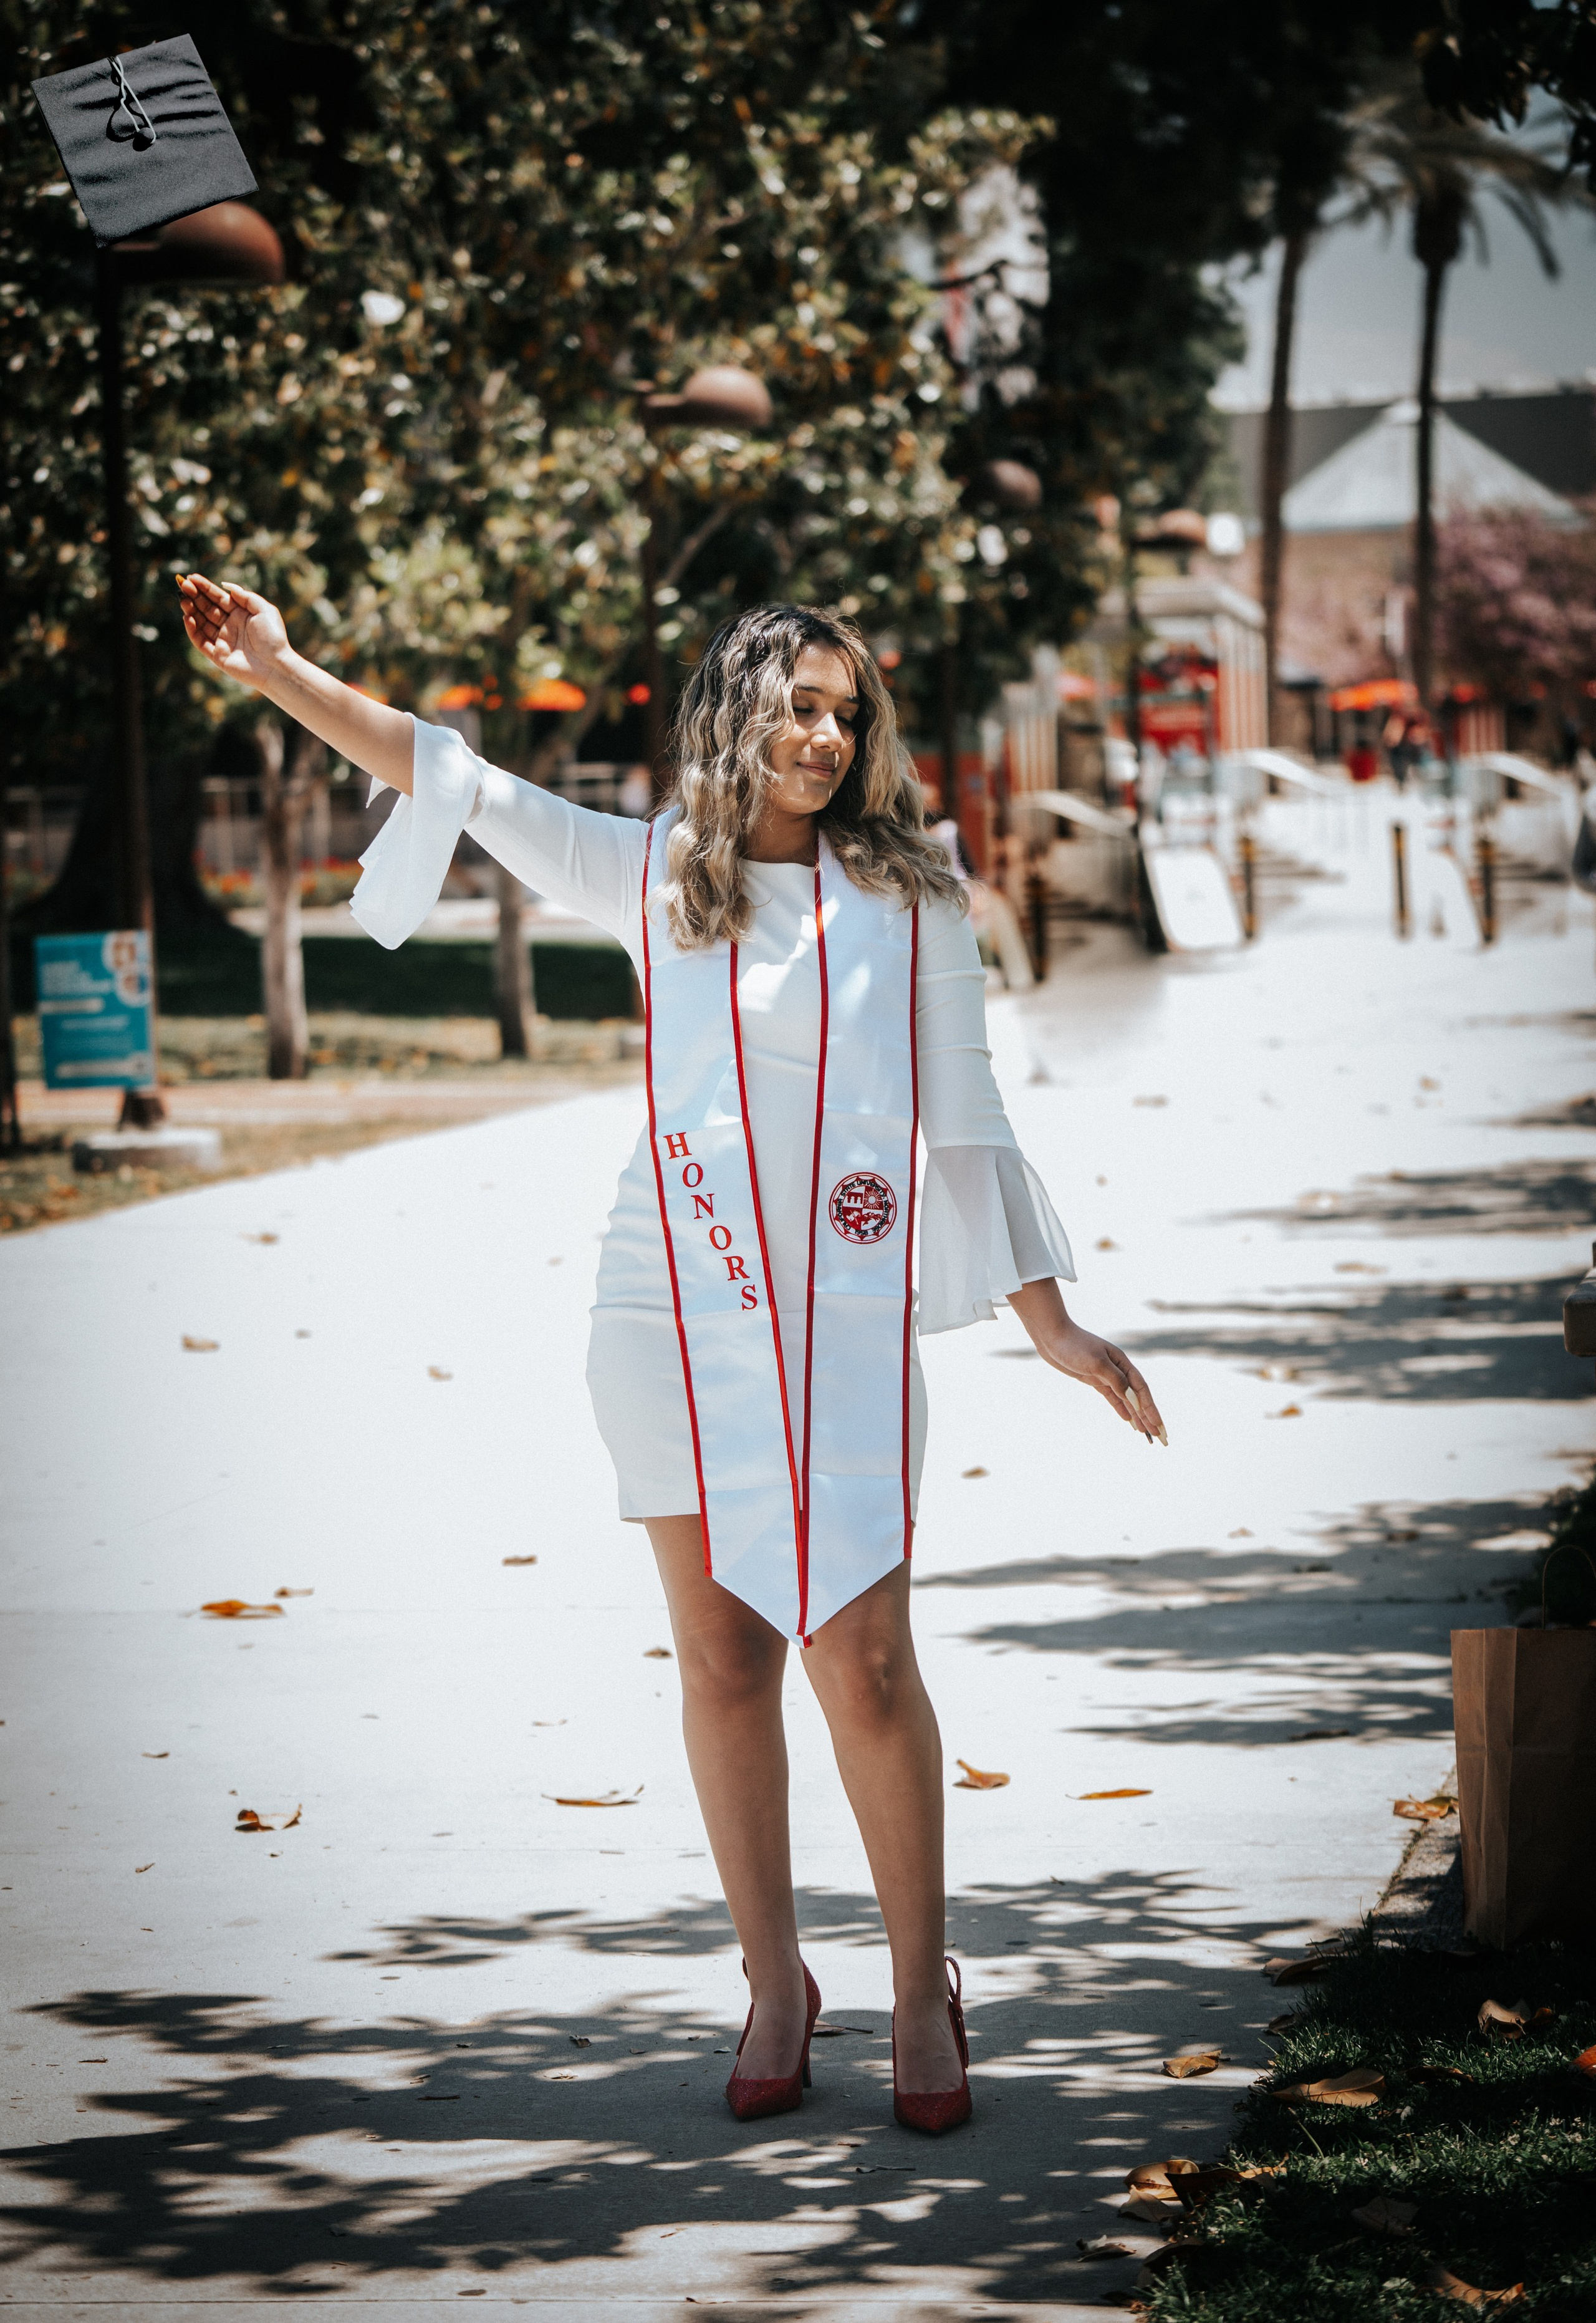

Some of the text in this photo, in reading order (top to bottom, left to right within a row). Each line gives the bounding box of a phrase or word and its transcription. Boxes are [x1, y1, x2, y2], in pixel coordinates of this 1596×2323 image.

[841, 1183, 856, 1196] STATE
[663, 1132, 758, 1310] HONORS
[837, 1199, 851, 1230] CALIFORNIA
